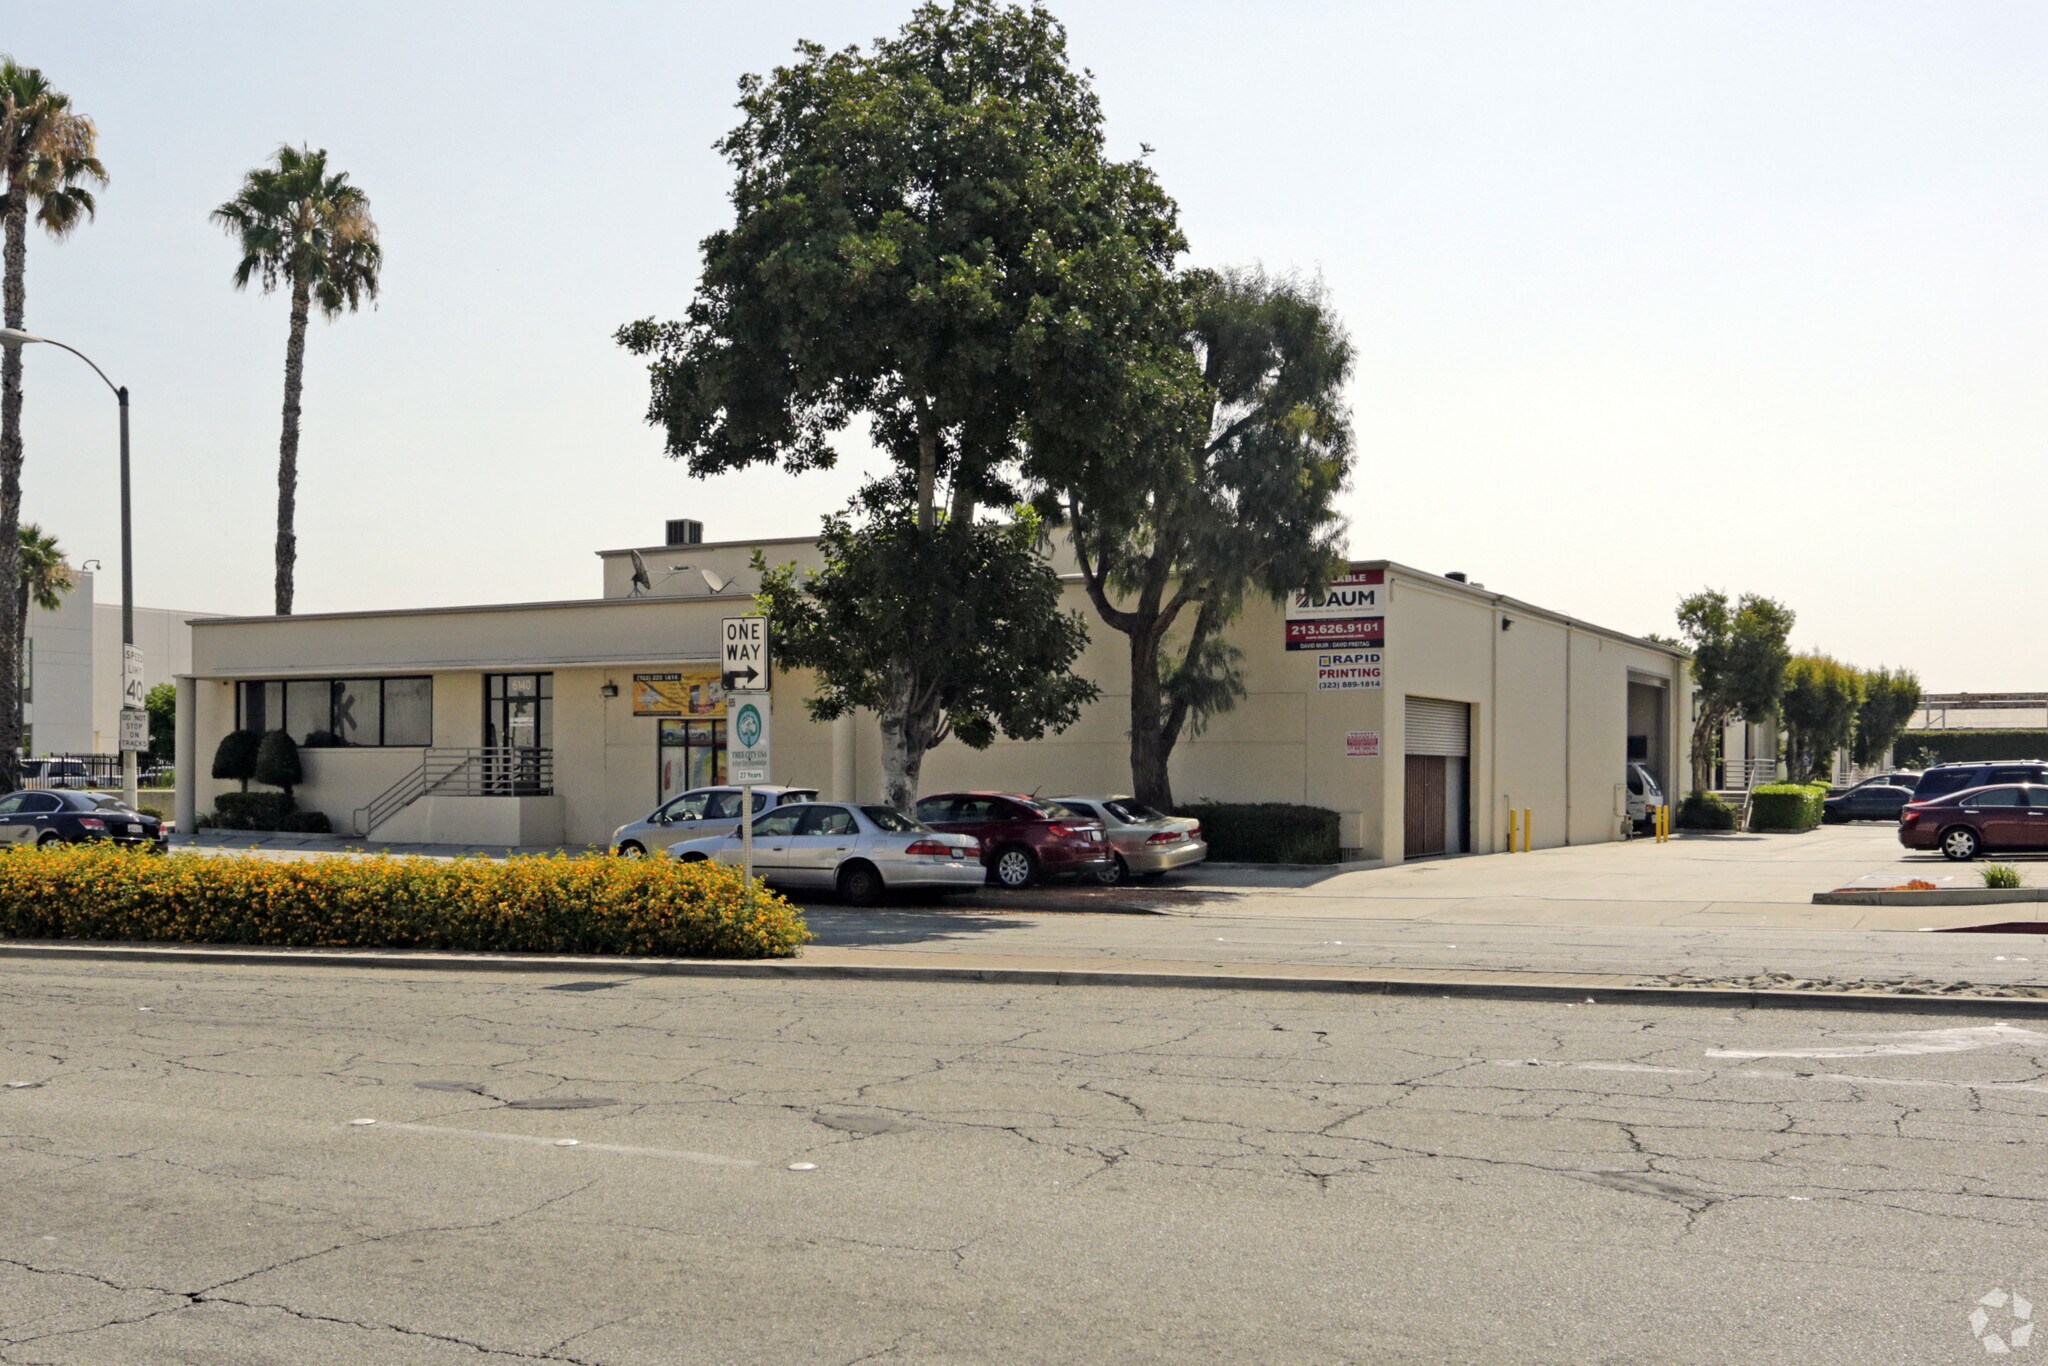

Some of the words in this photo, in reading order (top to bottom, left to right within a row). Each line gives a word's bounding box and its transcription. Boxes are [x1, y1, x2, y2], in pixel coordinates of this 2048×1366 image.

[727, 624, 760, 640] ONE
[1291, 622, 1379, 636] 213.626.9101
[1348, 640, 1370, 648] FREITAG
[726, 644, 761, 661] WAY
[1333, 654, 1380, 664] RAPID
[1319, 667, 1381, 679] PRINTING
[512, 680, 531, 690] 6140
[1319, 682, 1340, 690] (323)
[1342, 681, 1380, 689] 889-1814
[126, 679, 143, 702] 40
[126, 722, 143, 730] STOP
[732, 751, 744, 759] TREE
[744, 751, 756, 759] CITY
[757, 750, 767, 758] USA
